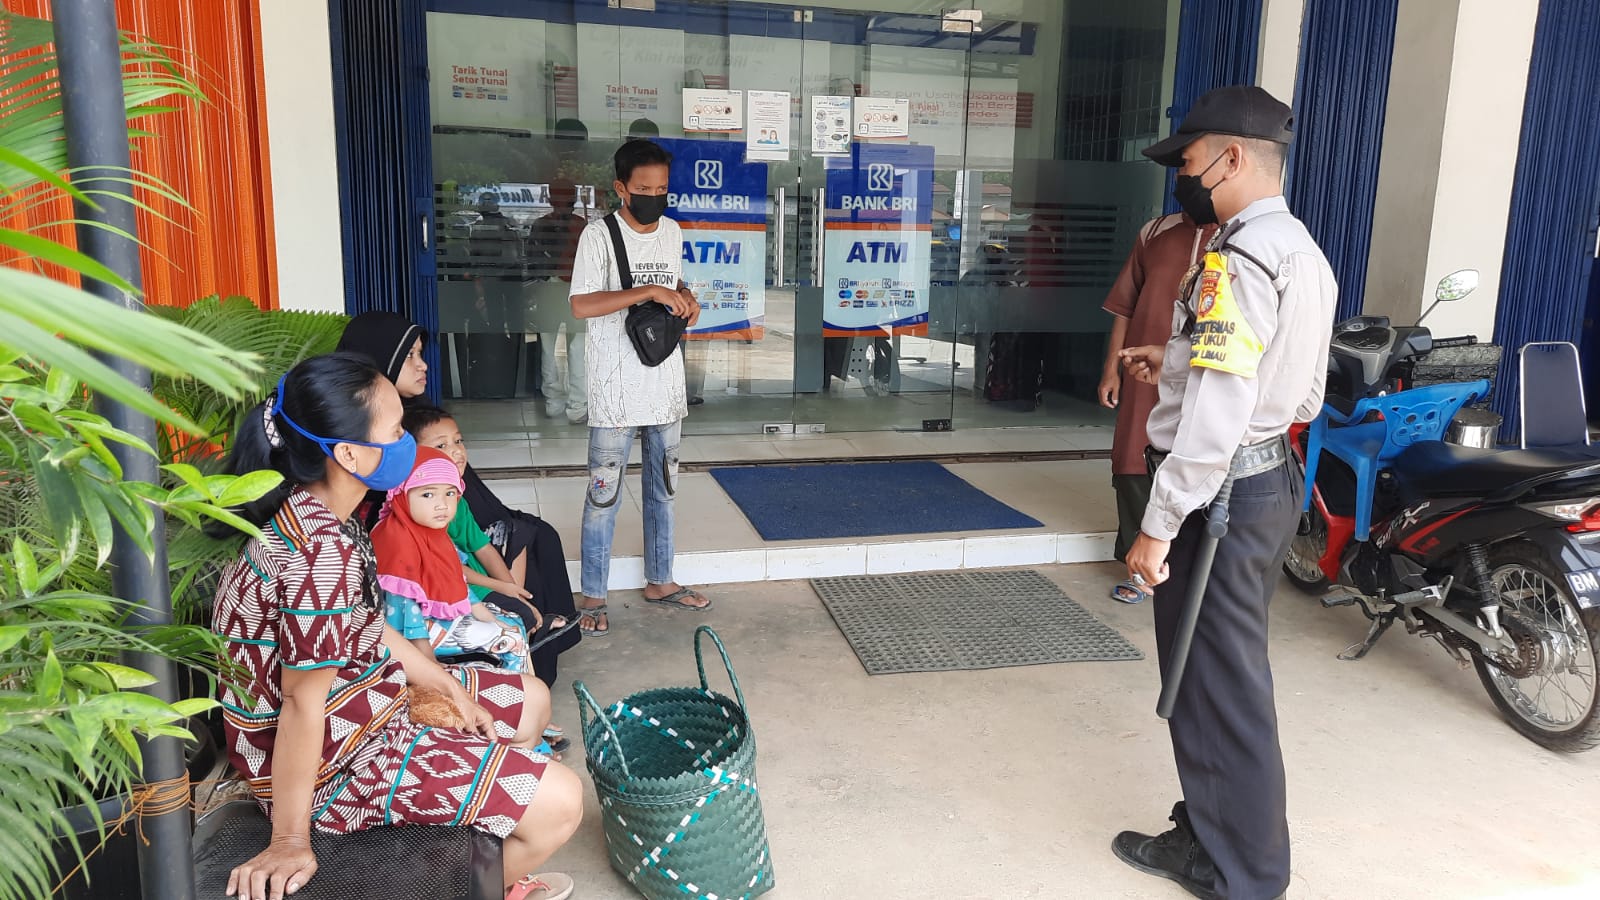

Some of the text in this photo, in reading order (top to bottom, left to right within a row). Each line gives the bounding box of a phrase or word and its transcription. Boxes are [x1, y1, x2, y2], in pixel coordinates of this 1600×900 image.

[452, 65, 508, 77] Tarik Tunai
[453, 74, 508, 86] Setor Tunai
[606, 84, 658, 96] Tarik Tunai
[666, 193, 750, 211] BANK BRI
[841, 195, 917, 211] BANK BRI
[681, 240, 741, 265] ATM
[845, 241, 908, 264] ATM
[632, 273, 674, 285] VACATION
[1203, 333, 1227, 347] UKUI
[1569, 571, 1600, 594] BM
